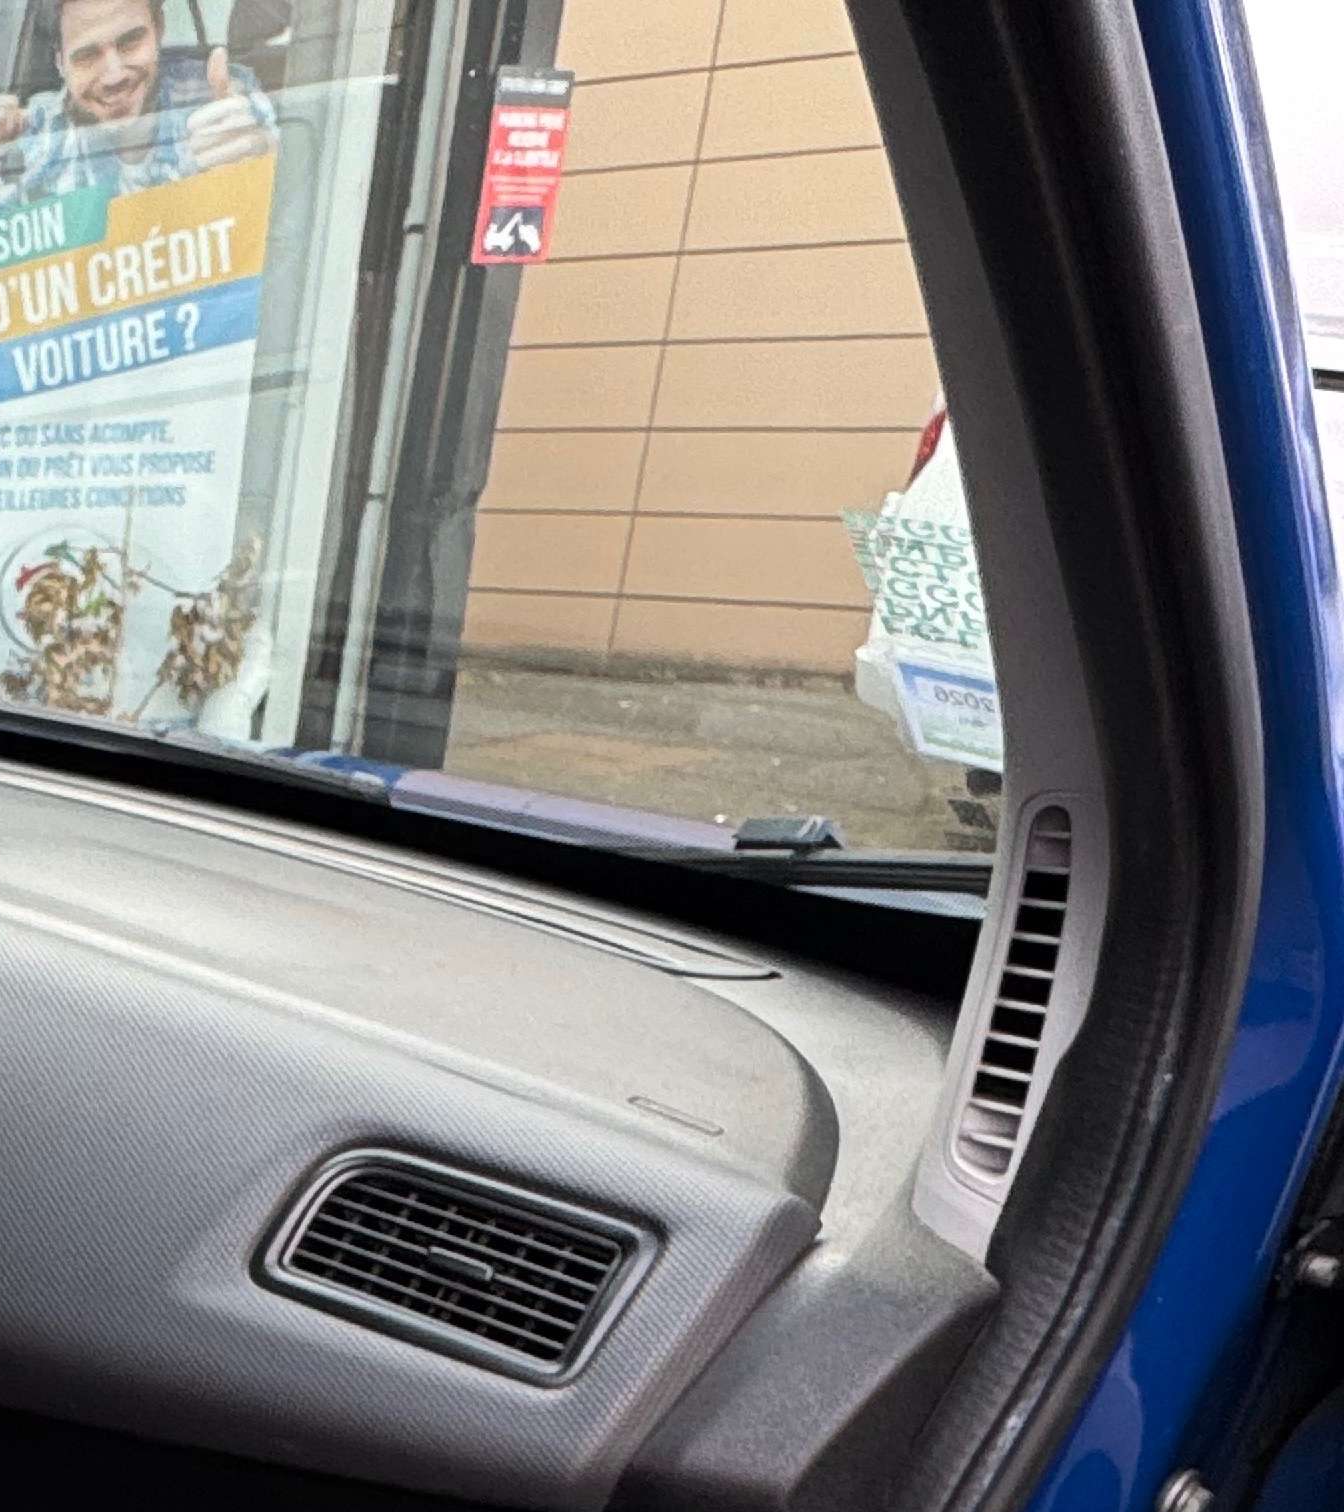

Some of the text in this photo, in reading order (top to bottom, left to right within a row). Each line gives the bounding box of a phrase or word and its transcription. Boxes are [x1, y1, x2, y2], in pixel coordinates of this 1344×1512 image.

[88, 216, 236, 307] CRÉDIT
[12, 302, 201, 392] VOITURE ?
[41, 422, 84, 446] SANS
[45, 450, 84, 477] PRÊT
[90, 453, 134, 477] VOUS
[138, 449, 215, 475] PROPOSE
